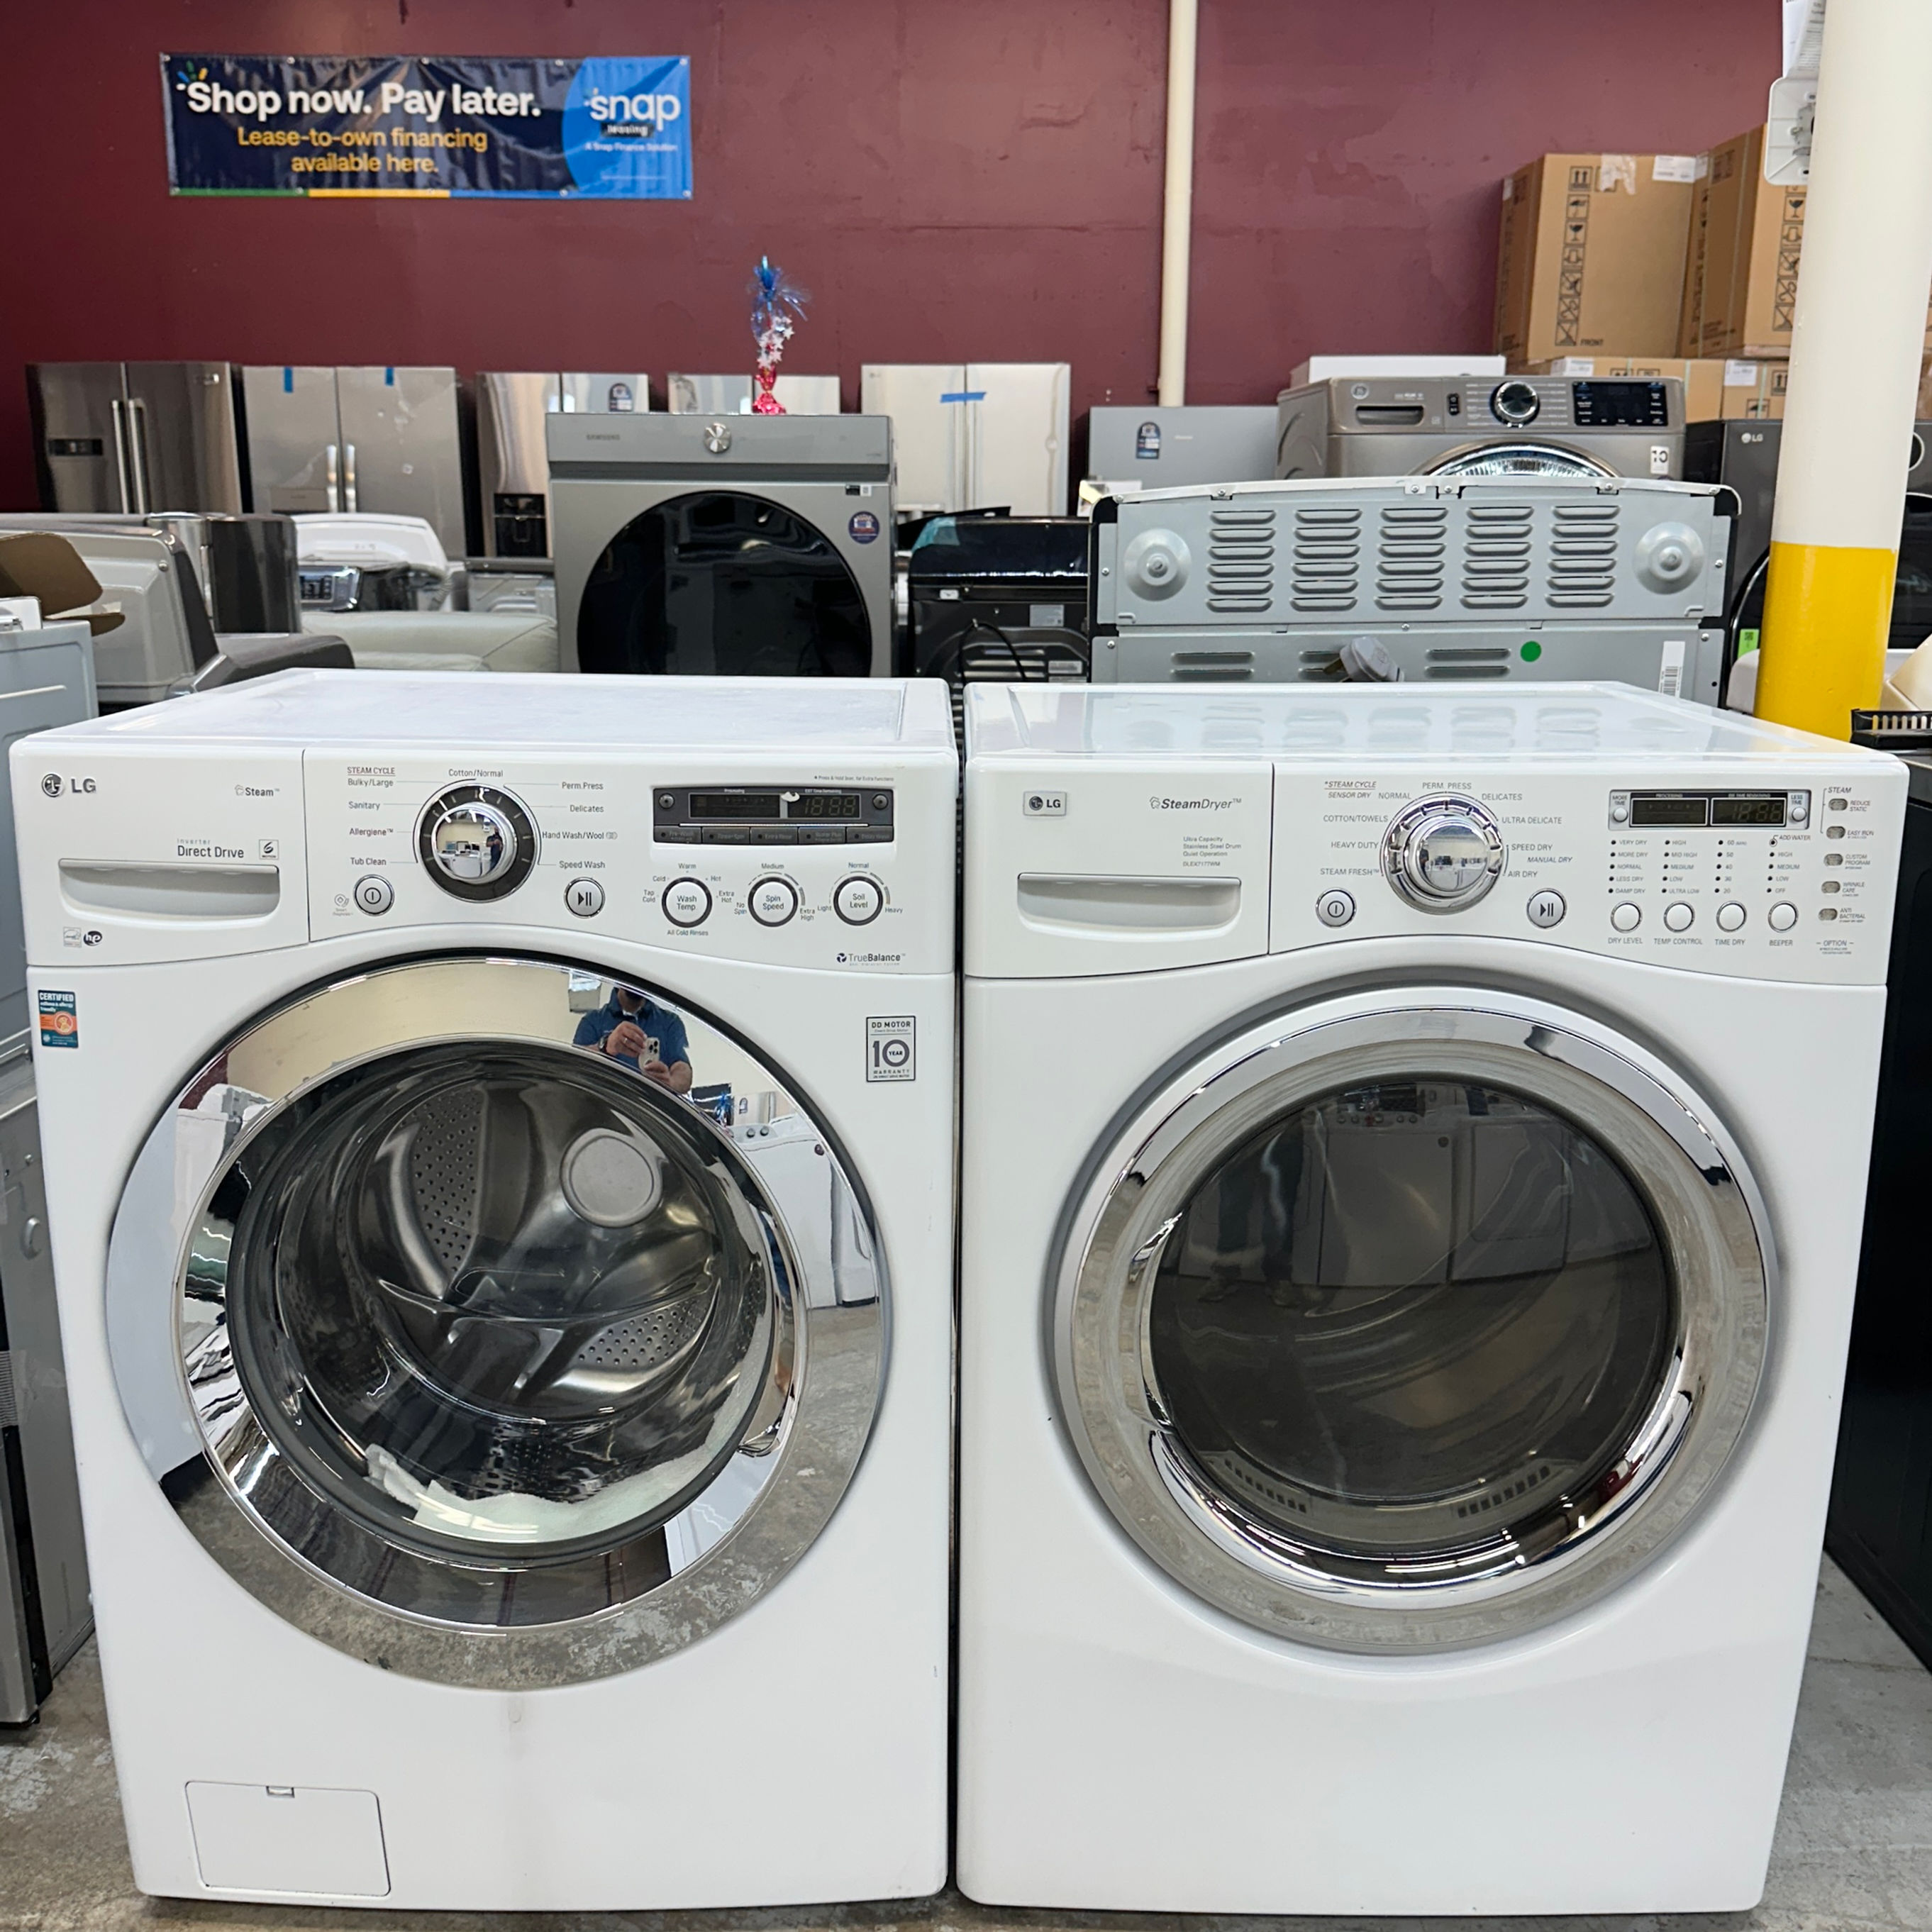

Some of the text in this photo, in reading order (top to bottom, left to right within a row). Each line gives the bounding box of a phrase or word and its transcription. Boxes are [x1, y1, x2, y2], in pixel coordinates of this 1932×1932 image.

[187, 81, 542, 121] Shop now. Pay later.
[590, 94, 681, 132] snap
[238, 127, 487, 152] Lease-to-own financing
[292, 152, 438, 173] available here.
[1751, 433, 1764, 442] LG
[448, 769, 504, 778] Cotton/Normal
[70, 778, 97, 794] LG
[348, 778, 394, 787] Bulky/Large
[348, 801, 381, 811] Sanitary
[570, 804, 604, 813] Delicates
[1046, 799, 1061, 809] LG
[562, 831, 604, 840] Wash/Wool
[177, 845, 245, 858] Direct Drive
[366, 857, 387, 866] Clean
[559, 860, 606, 870] Speed Wash
[766, 894, 781, 903] Spin
[677, 903, 696, 911] Temp
[762, 902, 784, 911] Speed
[39, 992, 74, 1002] CERTIFIED
[872, 1039, 910, 1067] 10
